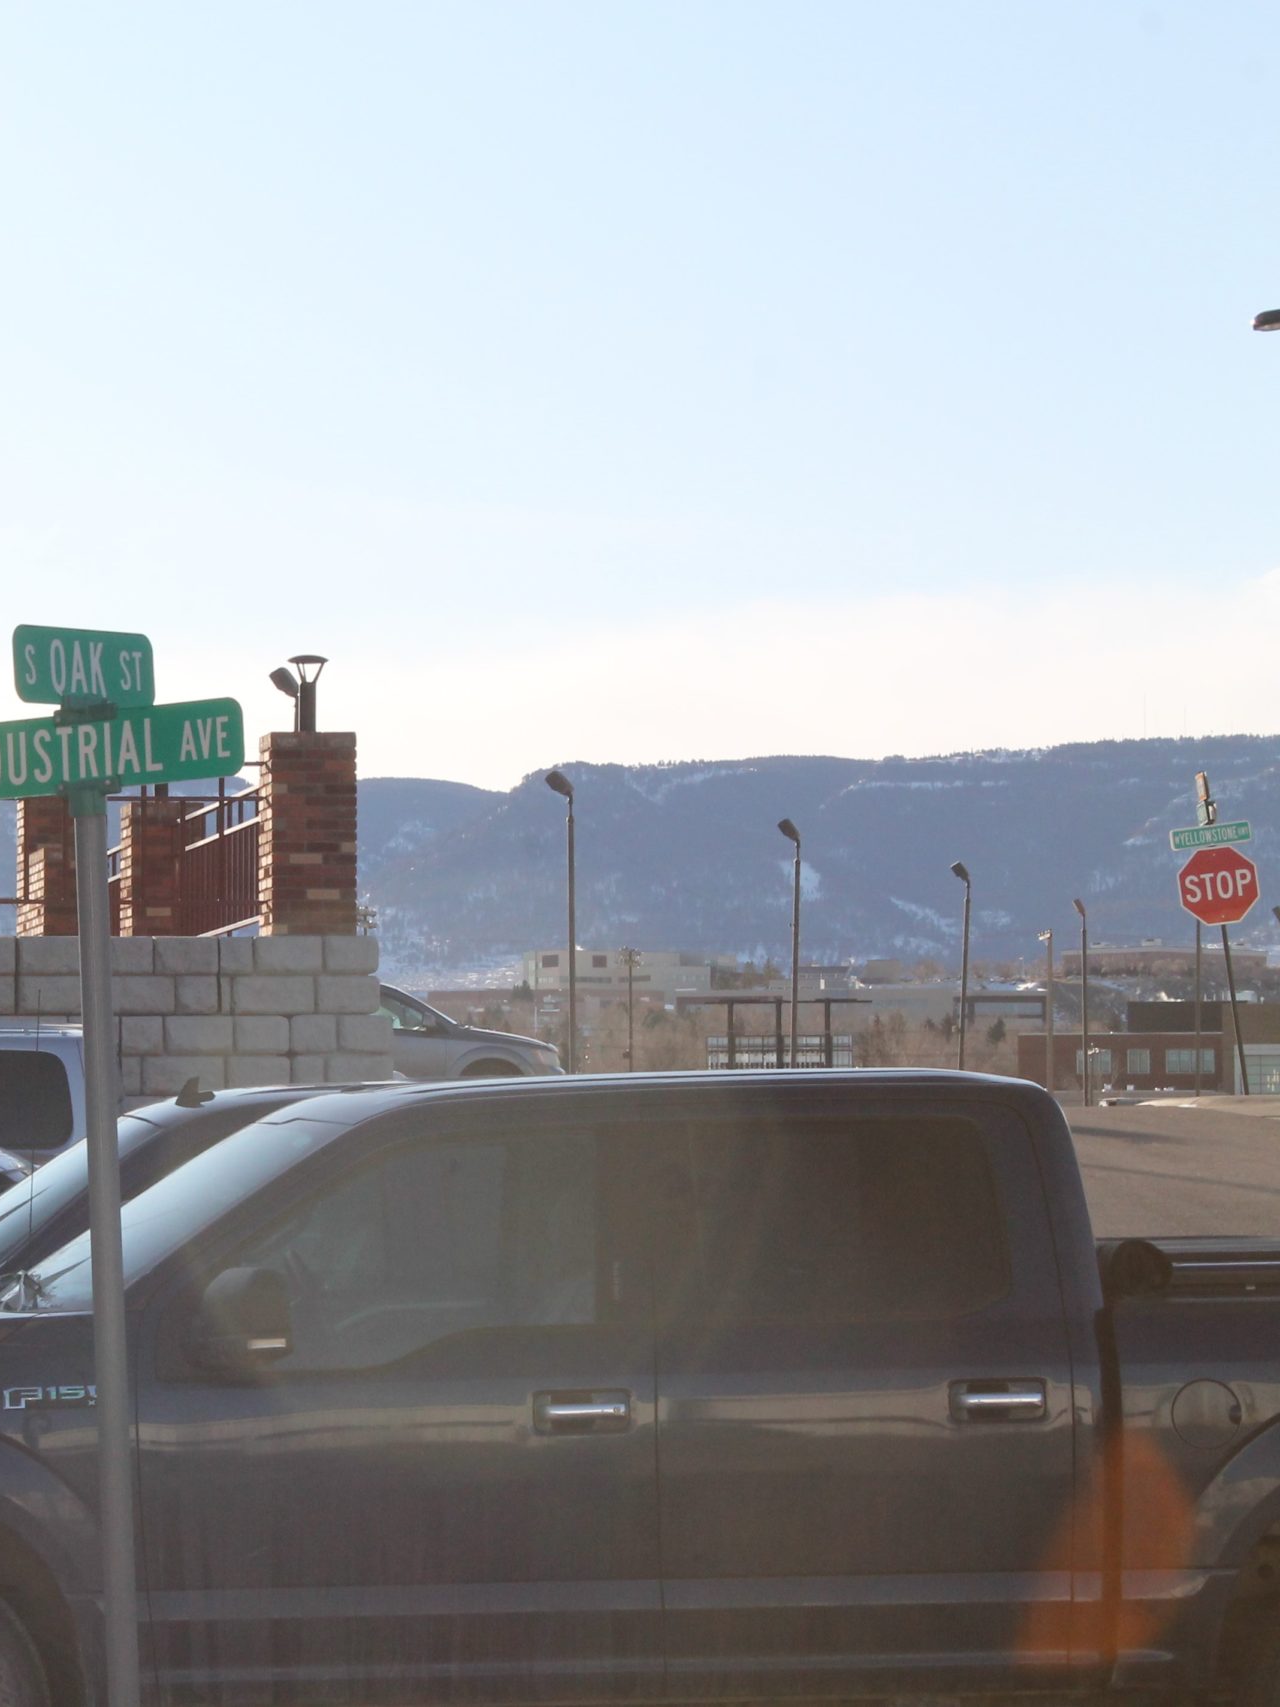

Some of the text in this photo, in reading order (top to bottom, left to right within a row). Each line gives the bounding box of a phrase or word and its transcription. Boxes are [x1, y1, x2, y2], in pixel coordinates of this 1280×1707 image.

[24, 638, 144, 698] S OAK ST
[179, 715, 231, 762] AVE
[1180, 825, 1238, 846] YELLOWSTONE
[1184, 868, 1252, 904] STOP
